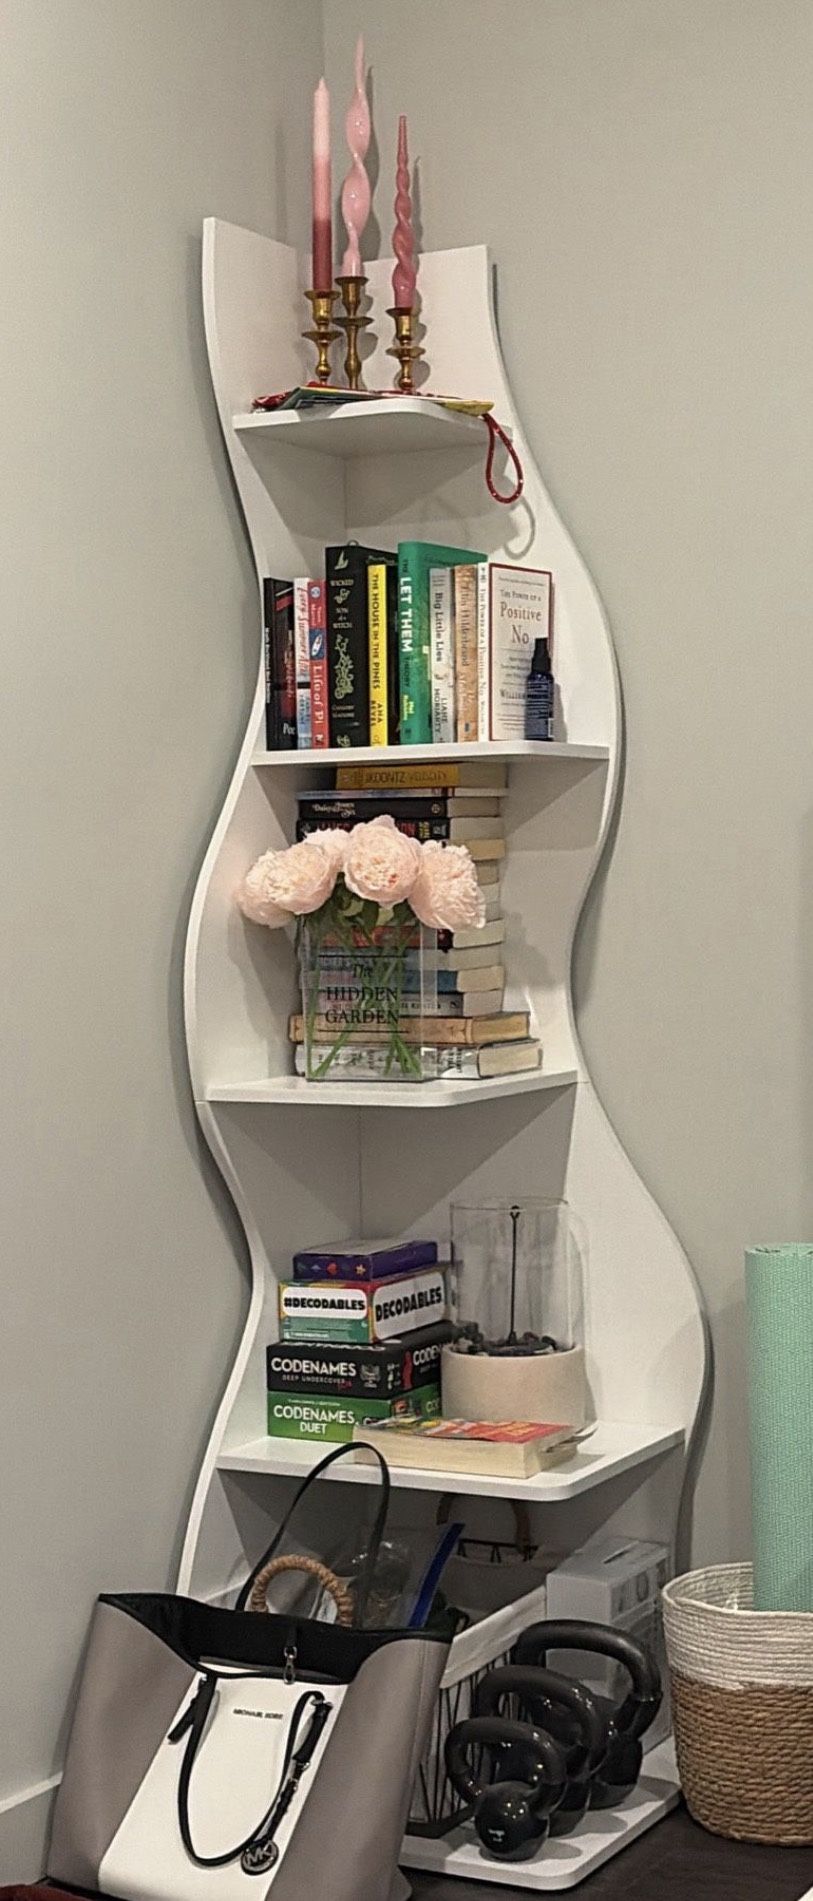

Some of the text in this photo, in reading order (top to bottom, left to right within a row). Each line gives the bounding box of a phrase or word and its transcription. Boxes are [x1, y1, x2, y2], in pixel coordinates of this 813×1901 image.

[372, 574, 380, 590] THE
[400, 577, 413, 604] LET
[371, 593, 380, 628] HOUSE
[500, 601, 542, 622] Positive
[400, 608, 413, 652] THEM
[433, 592, 446, 662] Big Little Lies
[511, 624, 530, 645] No
[372, 662, 381, 690] PINES
[325, 986, 398, 1002] HIDDEN
[324, 1009, 400, 1025] GARDEN
[283, 1297, 365, 1311] #DECODABLES
[375, 1285, 442, 1322] DECODABLES
[271, 1356, 356, 1377] CODENAMES
[273, 1404, 355, 1425] CODENAMES
[299, 1421, 327, 1436] DUET
